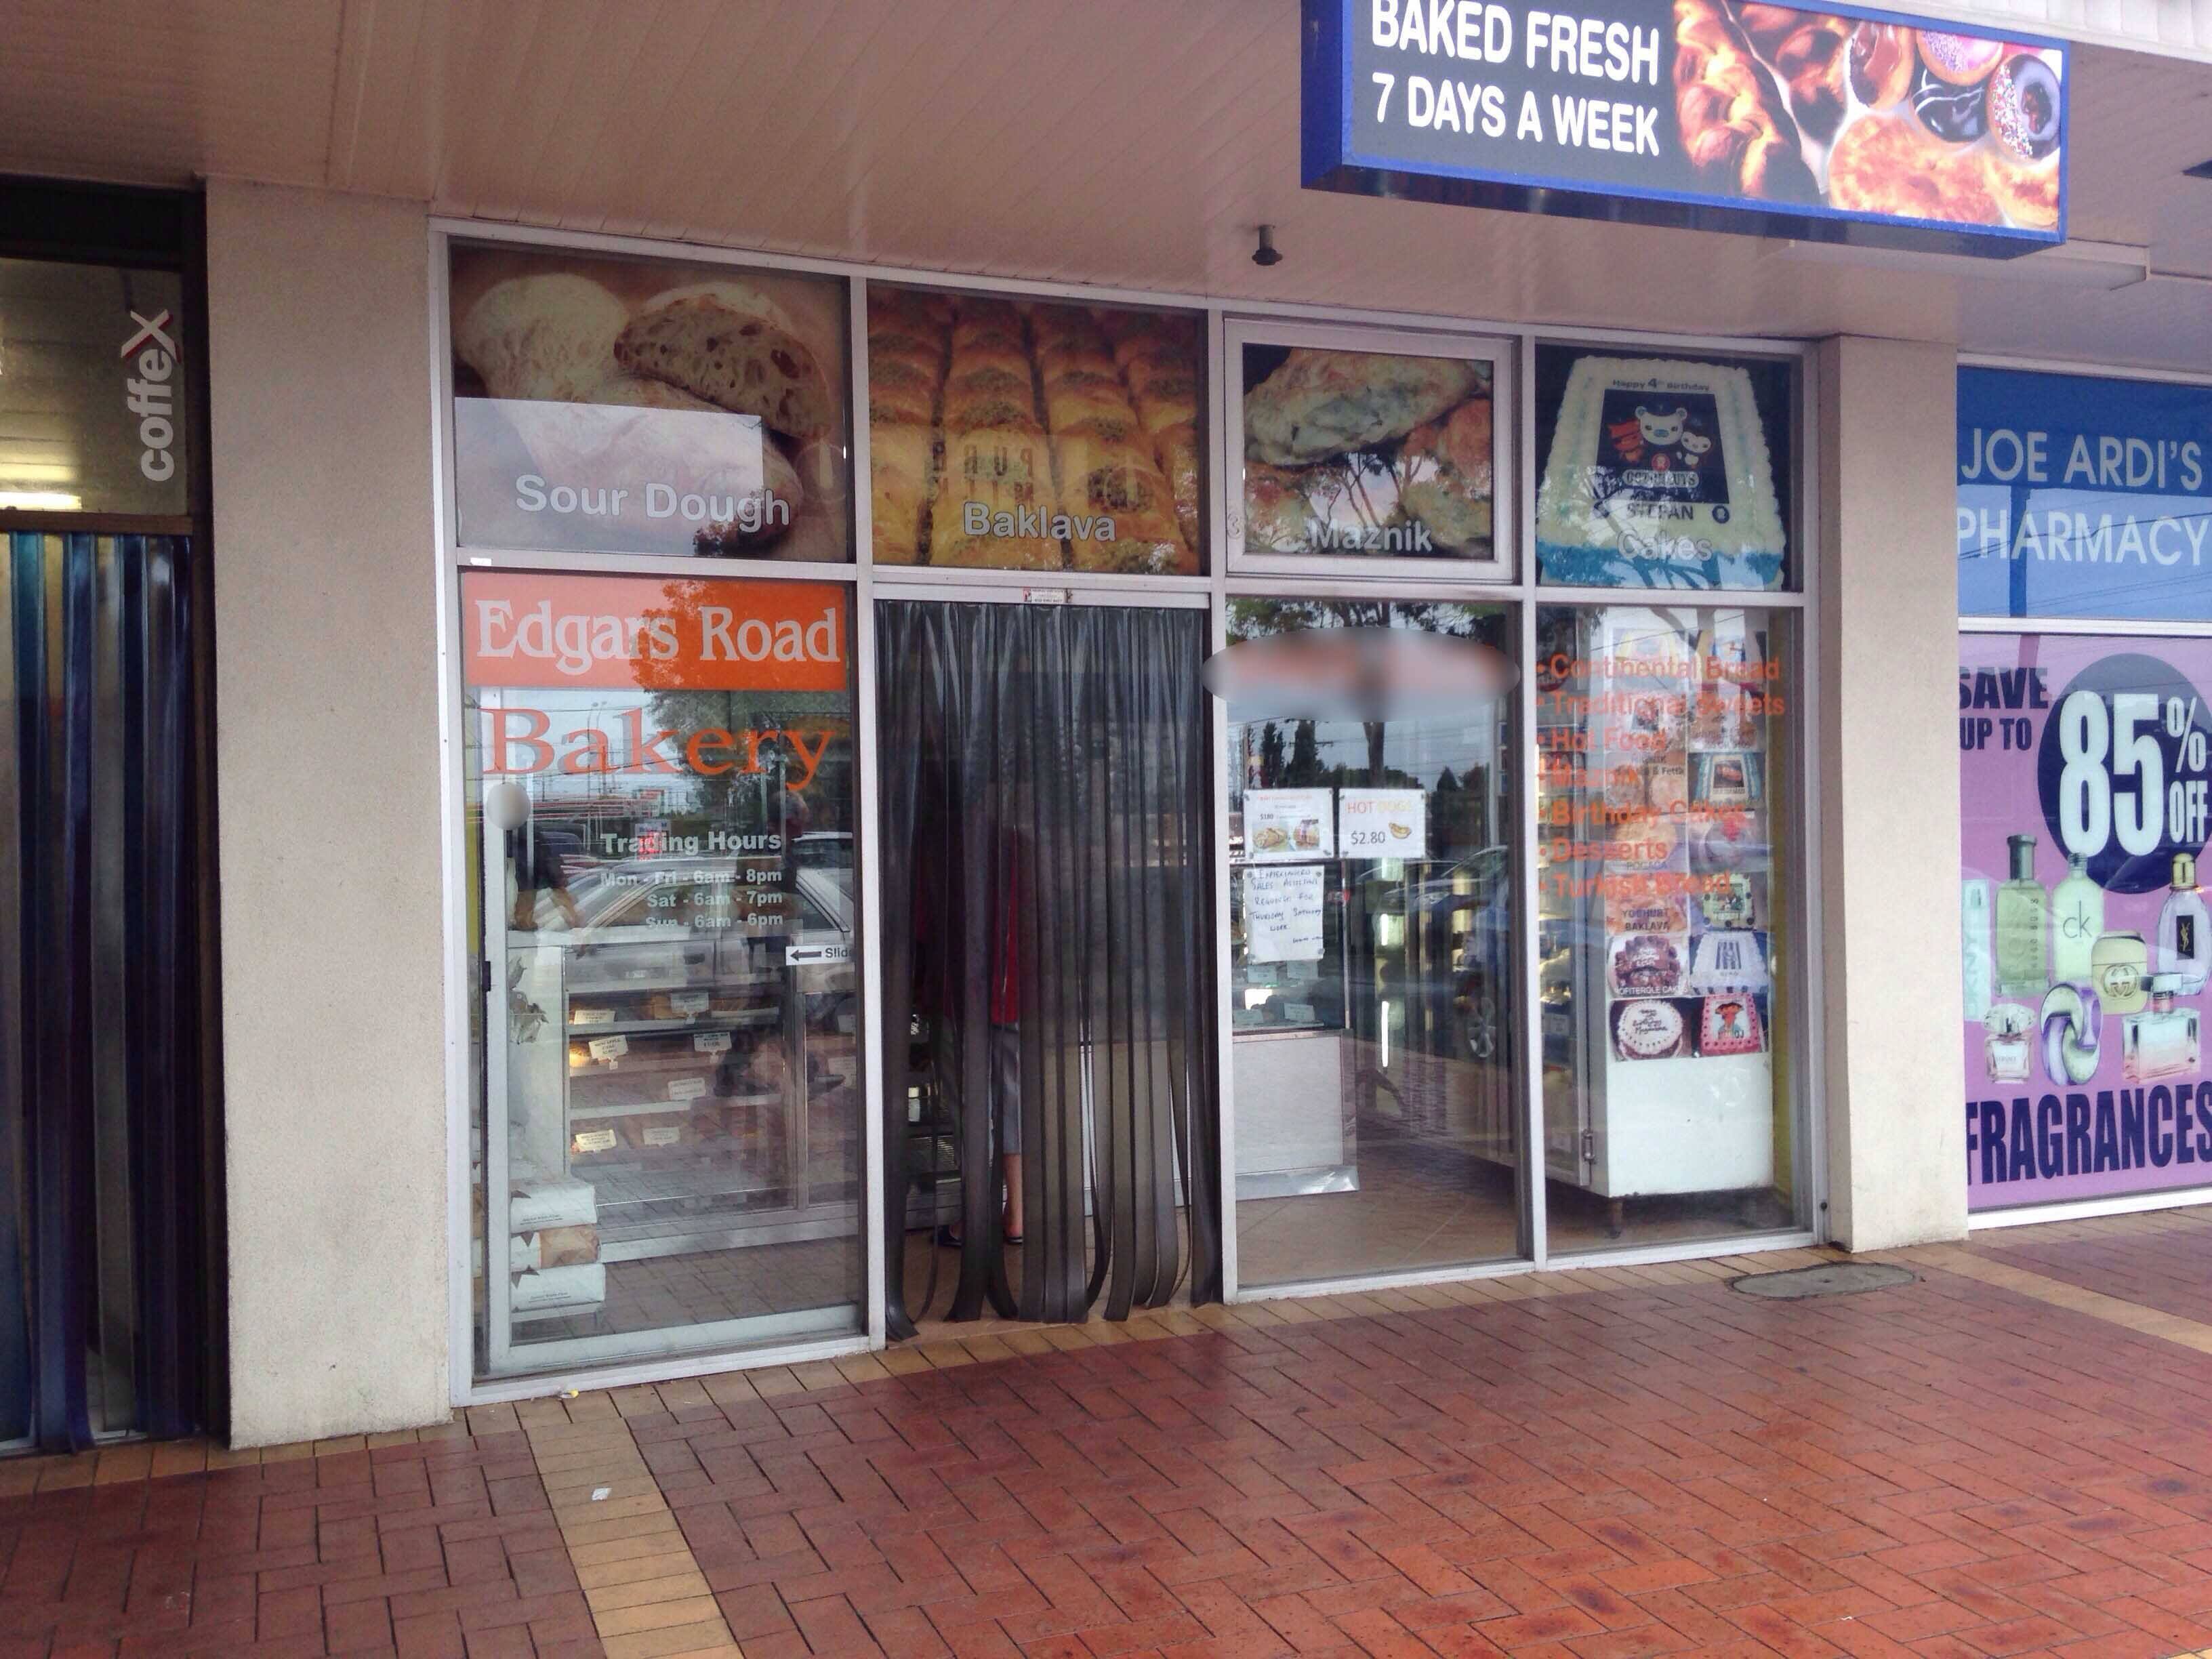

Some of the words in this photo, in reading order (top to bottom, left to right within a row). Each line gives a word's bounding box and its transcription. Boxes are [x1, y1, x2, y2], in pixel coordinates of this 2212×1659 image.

[1372, 0, 1512, 62] BAKED
[1525, 11, 1660, 86] FRESH
[1371, 72, 1395, 123] 7
[1407, 75, 1507, 138] DAYS
[1515, 89, 1544, 142] A
[1551, 94, 1660, 157] WEEK
[1961, 428, 2048, 483] JOE
[2063, 434, 2203, 491] ARDI'S
[515, 473, 629, 516] Sour
[645, 482, 790, 534] Dough
[962, 500, 1118, 542] Baklava
[1306, 518, 1433, 553] Maznik
[1618, 529, 1713, 561] Cakes
[1957, 508, 2209, 567] PHARMACY
[474, 600, 680, 676] Edgars
[699, 605, 842, 663] Road
[478, 706, 838, 792] Bakery
[1603, 726, 1666, 750] Food
[1959, 717, 1993, 751] UP
[1999, 717, 2032, 751] TO
[1347, 801, 1373, 814] HOT
[2169, 780, 2208, 844] OFF
[600, 832, 699, 857] Trading
[708, 830, 782, 851] Hours
[1351, 830, 1386, 845] $2.80
[1553, 836, 1668, 863] Desserts
[600, 872, 638, 887] Mon
[655, 870, 677, 885] Fri
[693, 869, 731, 884] 6am
[745, 868, 782, 886] 8pm
[647, 894, 677, 907] Sat
[693, 892, 731, 905] 6am
[746, 890, 783, 907] 7pm
[645, 916, 678, 929] Sun
[693, 914, 732, 928] 6am
[747, 912, 783, 930] 6pm
[2062, 900, 2093, 939] ck
[1965, 1081, 2212, 1186] FRAGRANCES
